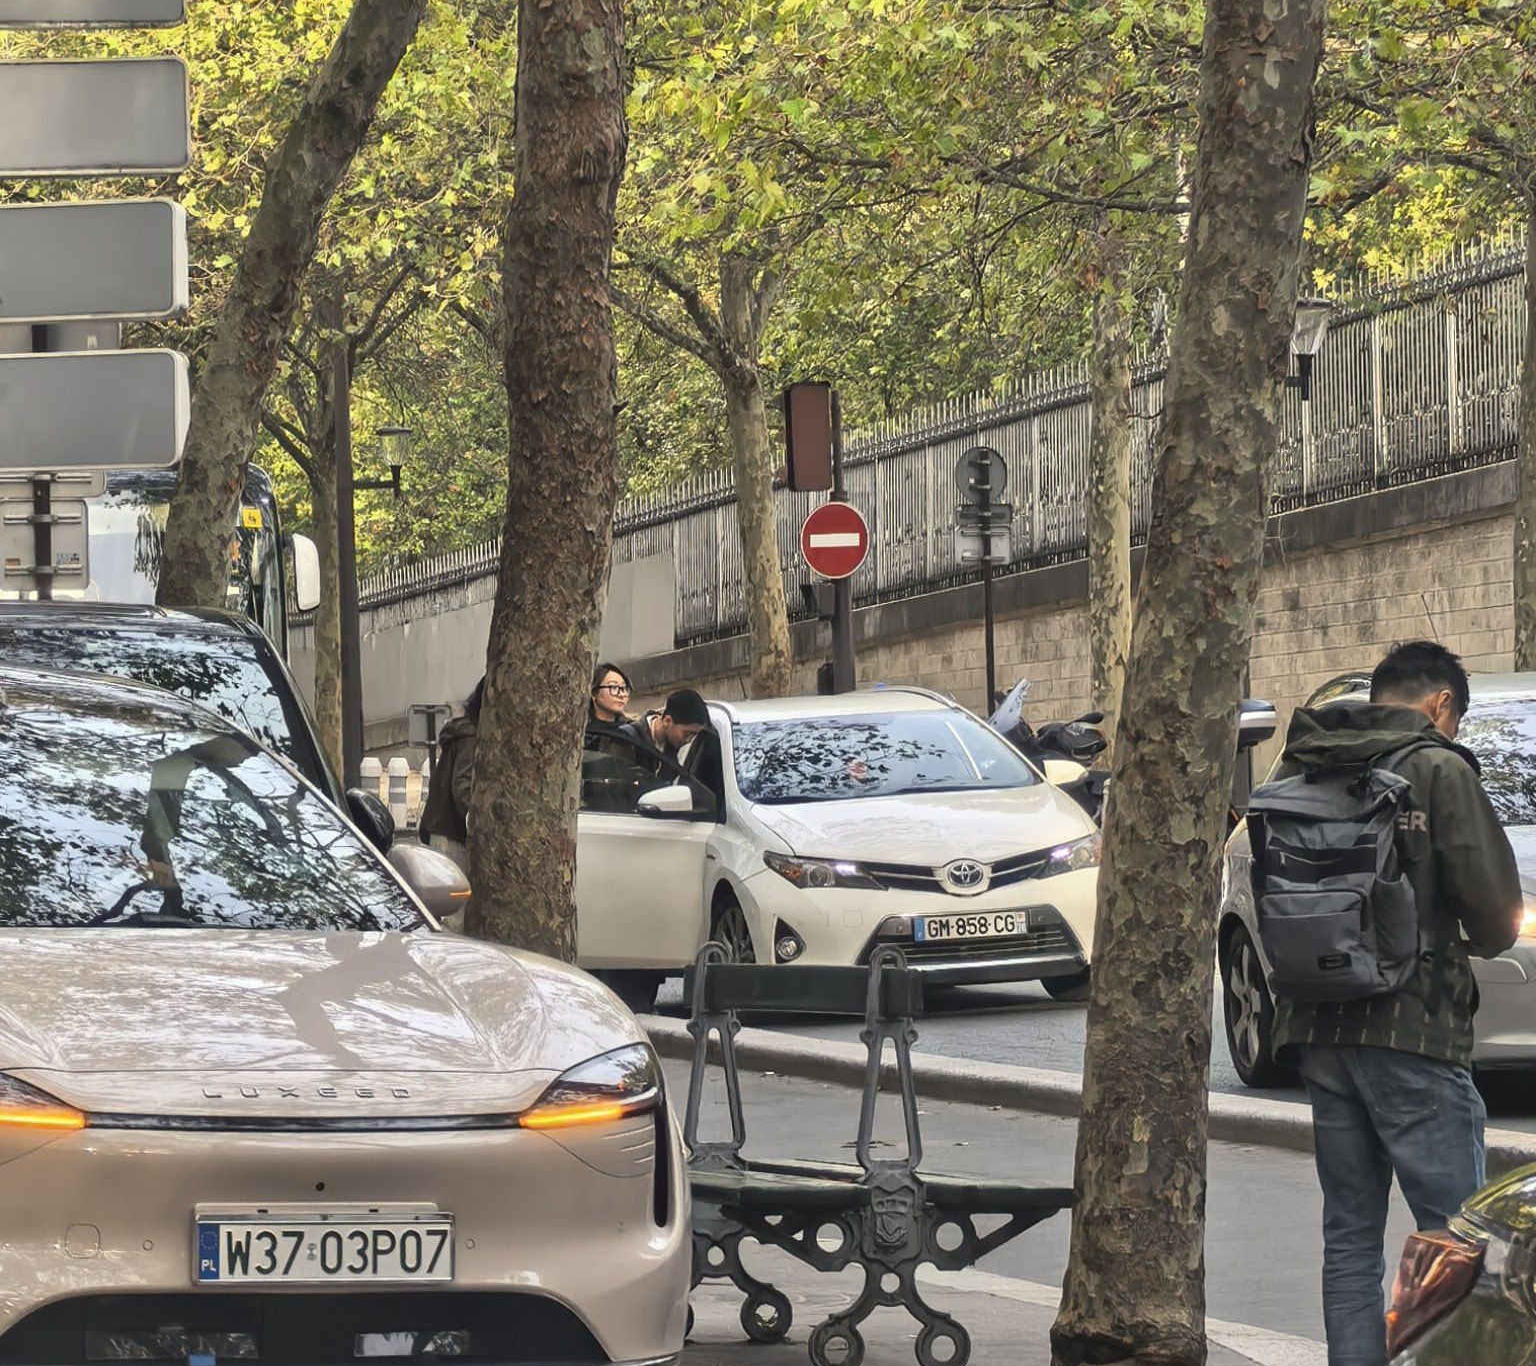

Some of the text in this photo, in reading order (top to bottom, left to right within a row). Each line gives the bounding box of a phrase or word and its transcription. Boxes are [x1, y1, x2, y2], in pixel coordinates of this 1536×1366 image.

[927, 914, 1015, 938] GM-858-CG
[202, 1087, 411, 1099] LUXEED
[201, 1259, 217, 1272] PL
